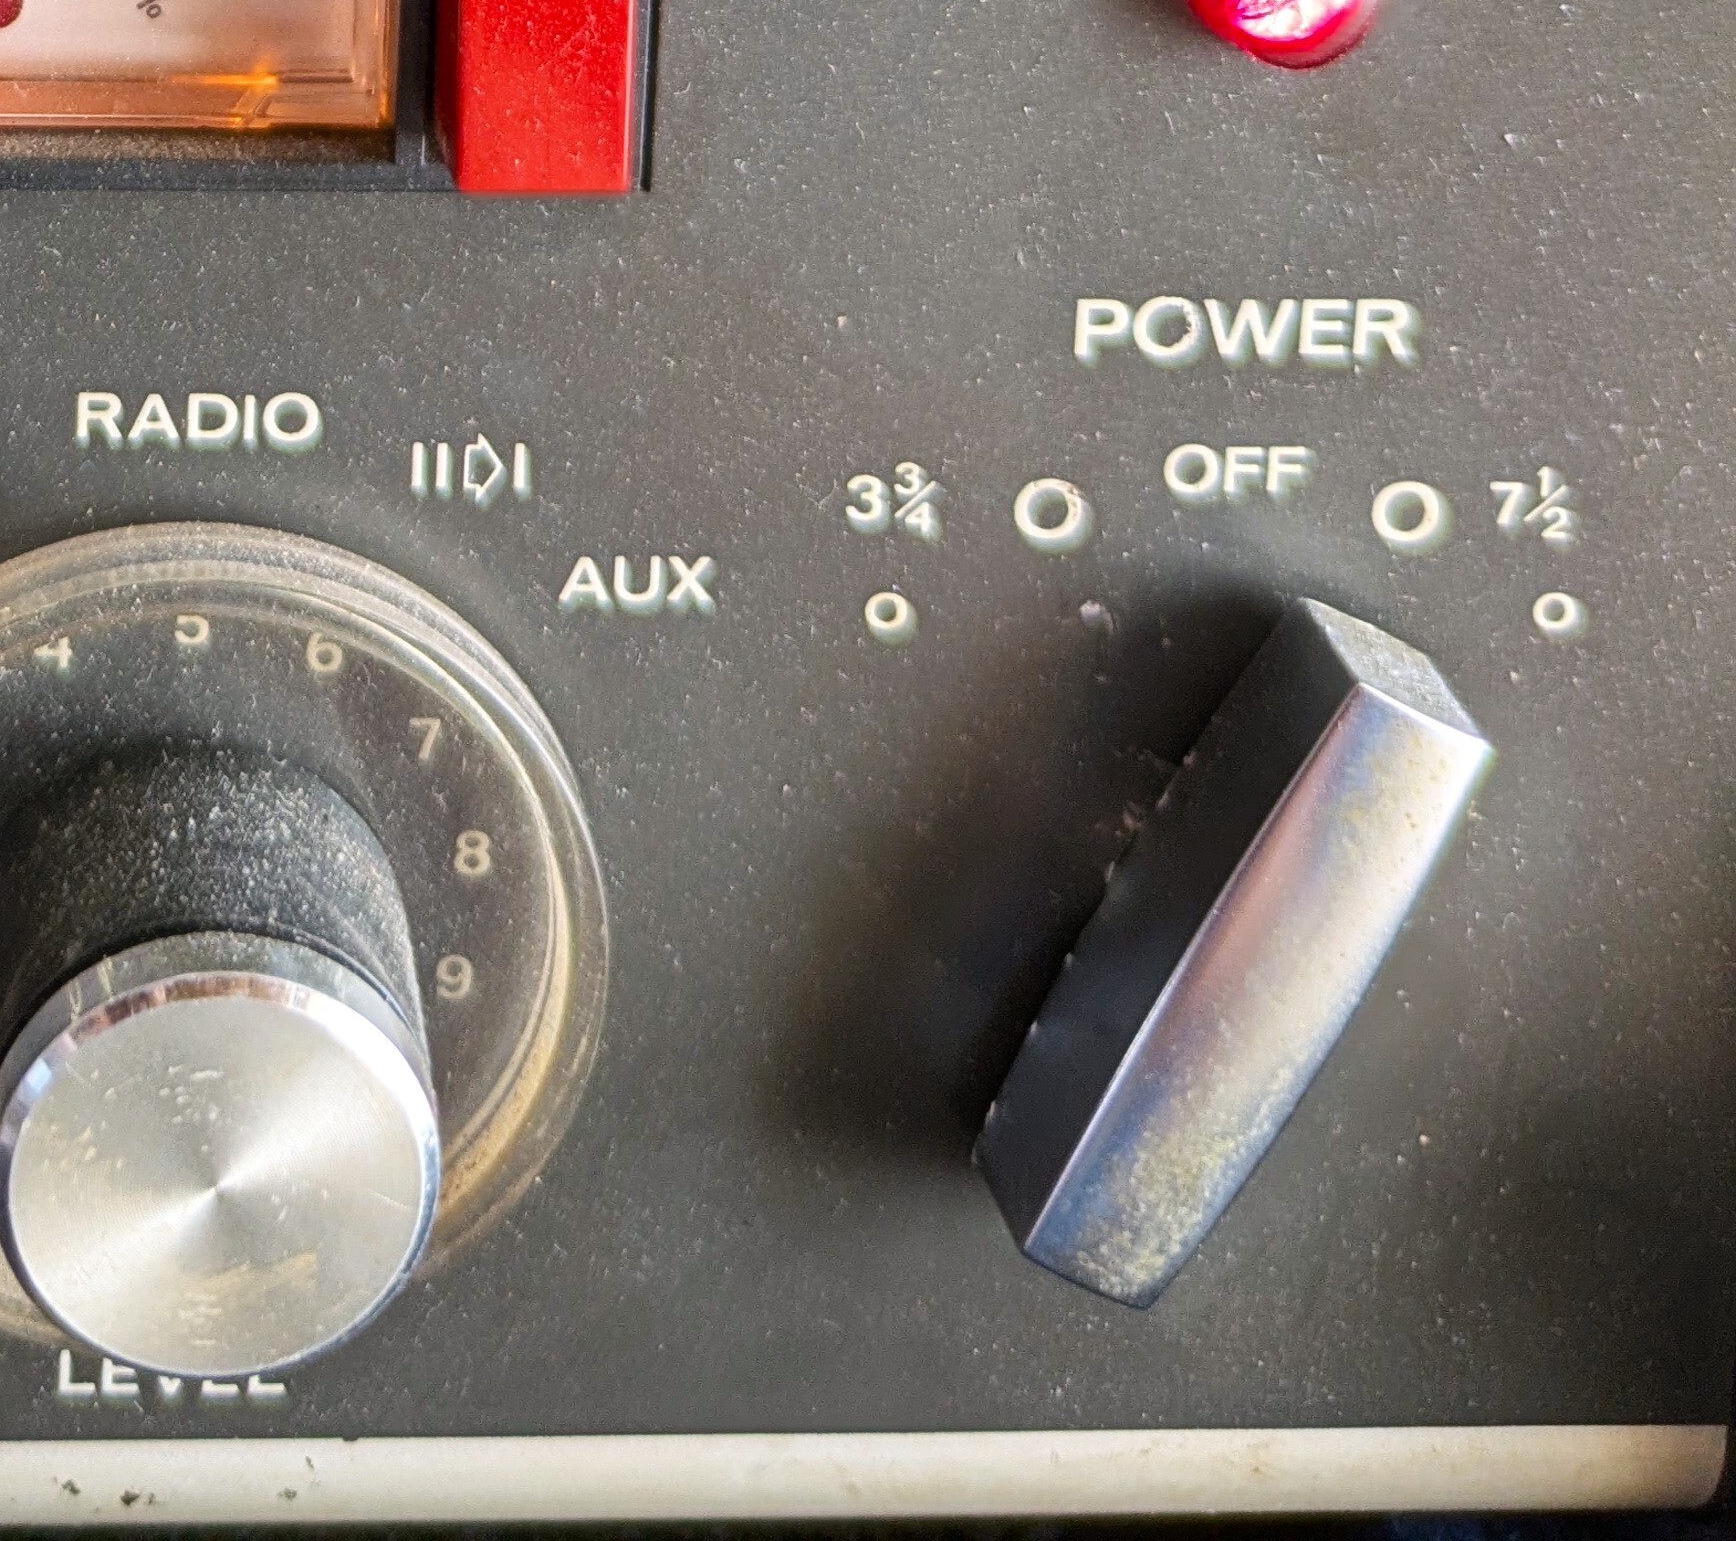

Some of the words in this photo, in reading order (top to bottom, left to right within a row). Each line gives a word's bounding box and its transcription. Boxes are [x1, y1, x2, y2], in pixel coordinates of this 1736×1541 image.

[1073, 295, 1416, 360] POWER
[75, 391, 322, 447] RADIO
[1163, 442, 1310, 499] OFF
[558, 554, 716, 607] AUX
[34, 636, 73, 669] 4
[306, 631, 344, 673] 6
[408, 717, 442, 761] 7
[454, 828, 492, 876] 8
[435, 953, 473, 1000] 9
